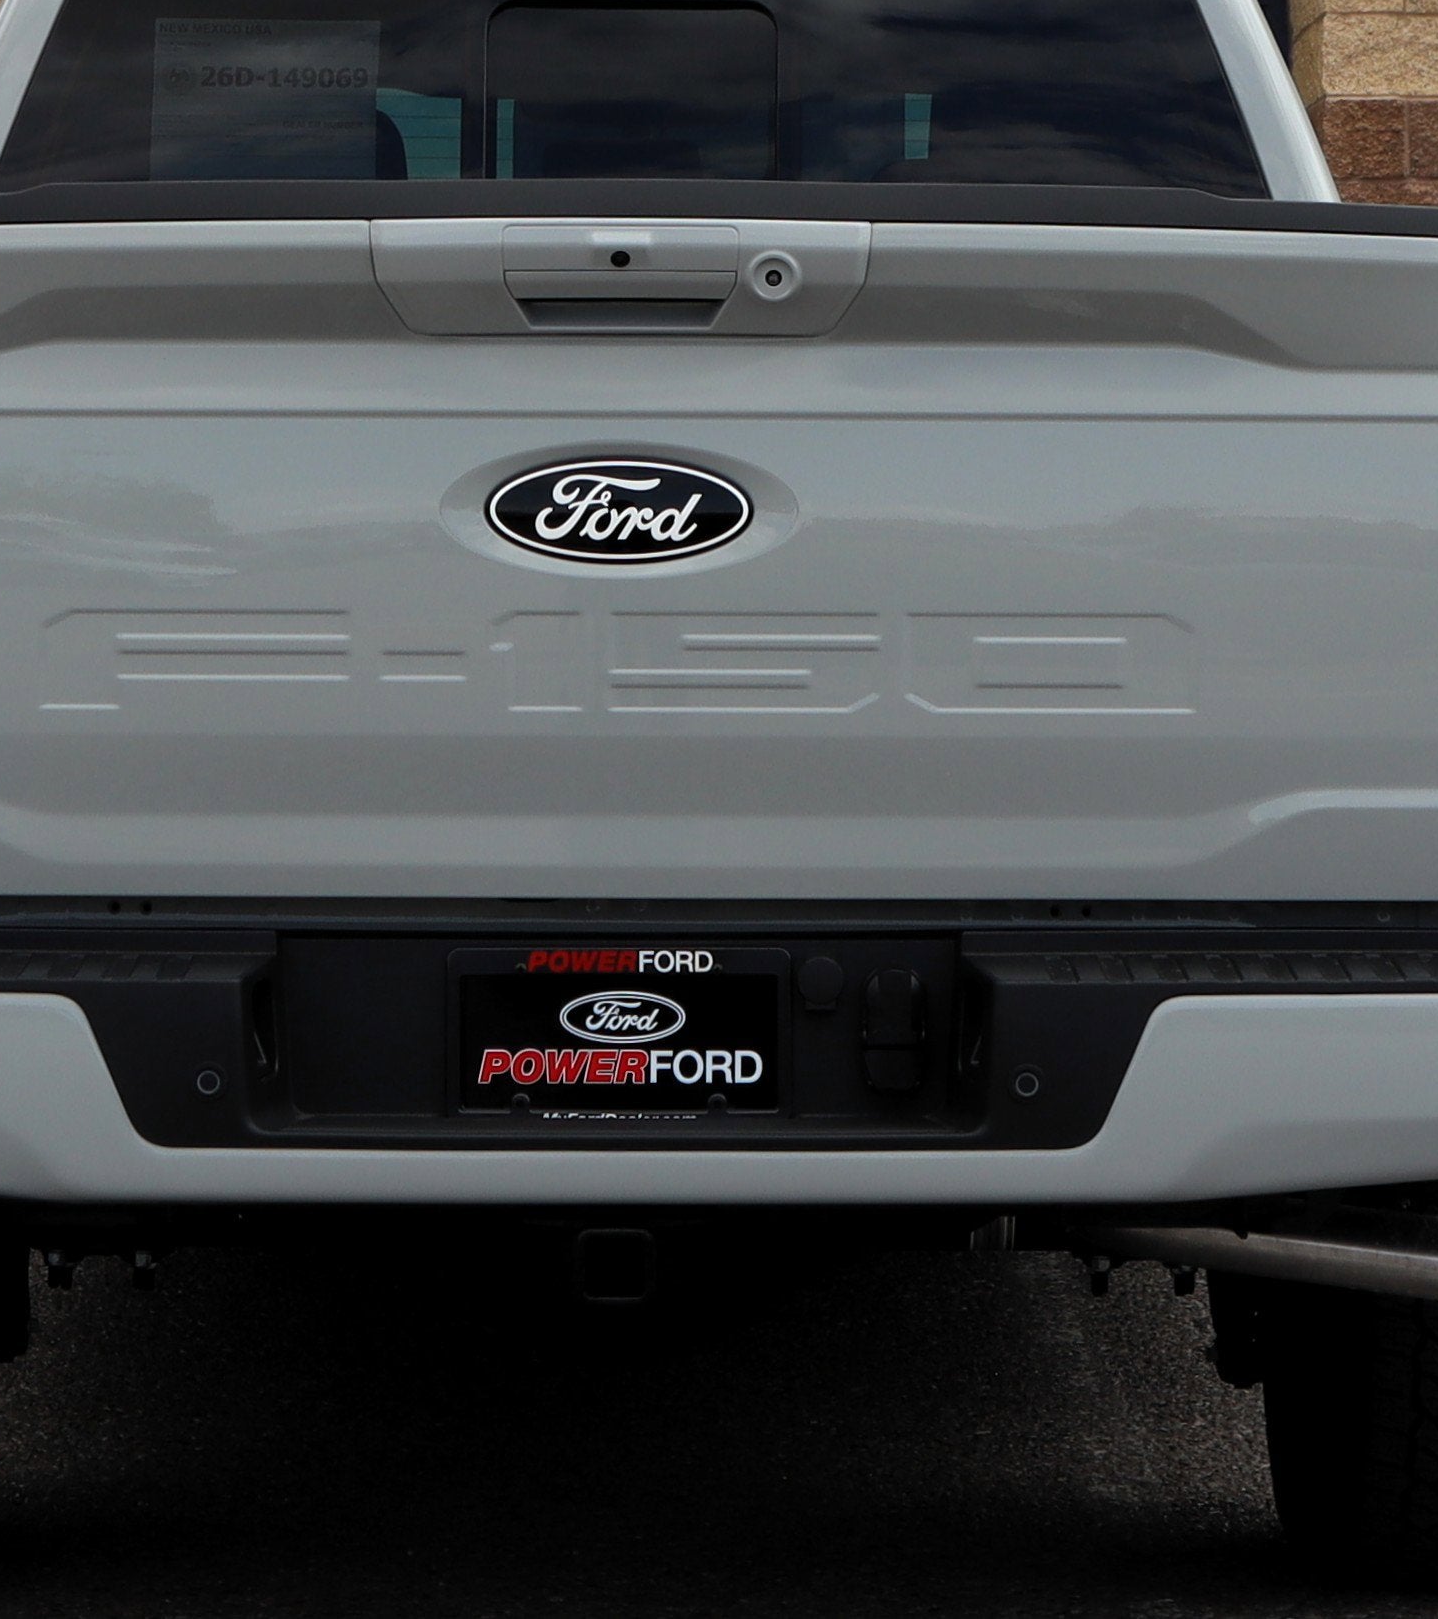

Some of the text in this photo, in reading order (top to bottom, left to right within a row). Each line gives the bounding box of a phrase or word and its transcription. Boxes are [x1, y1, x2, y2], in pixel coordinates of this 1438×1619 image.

[159, 23, 272, 35] NEW MEXICO USA
[200, 66, 369, 88] 26D-149069
[535, 473, 703, 542] Ford
[527, 950, 714, 973] POWERFORD
[585, 1000, 659, 1031] Ford
[478, 1048, 763, 1084] POWERFORD
